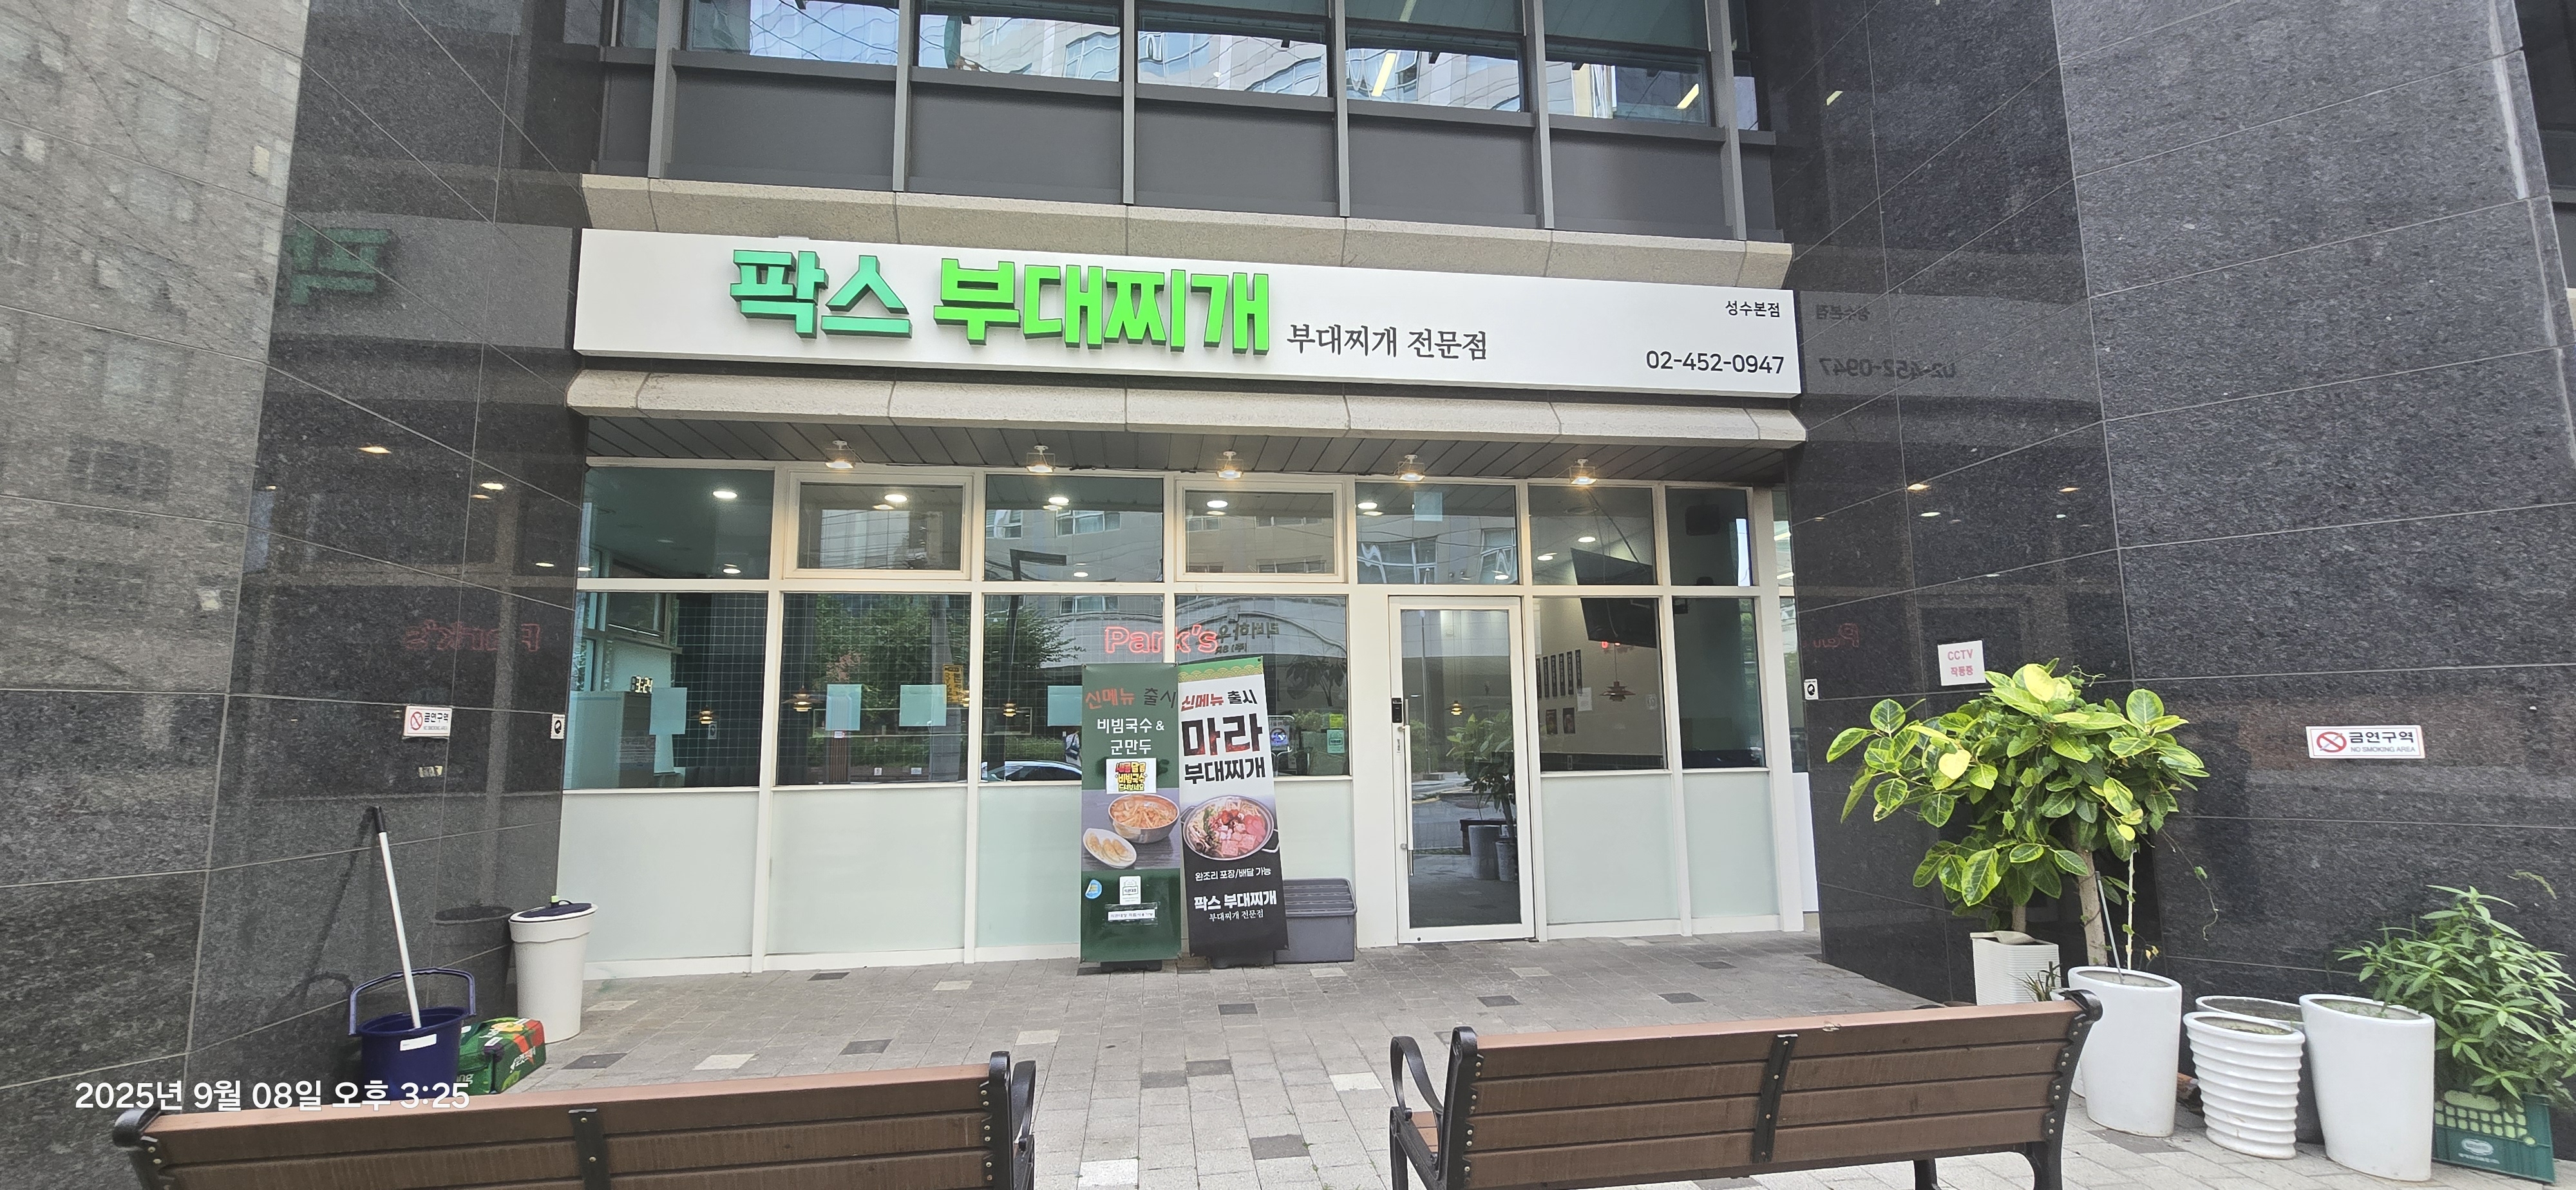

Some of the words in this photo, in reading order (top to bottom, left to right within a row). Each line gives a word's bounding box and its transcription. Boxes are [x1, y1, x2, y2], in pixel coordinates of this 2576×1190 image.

[730, 249, 913, 339] 팍스
[933, 258, 1270, 356] 부대찌개
[1725, 300, 1781, 317] 성수본점
[1287, 324, 1397, 357] 부대찌개
[1408, 328, 1486, 361] 전문점
[1646, 350, 1785, 374] 02-452-0947
[1947, 649, 1973, 661] CCTV
[1951, 666, 1973, 677] 작동중
[1085, 688, 1135, 710] 신메뉴
[1144, 688, 1177, 708] 출시
[1181, 694, 1224, 712] 신메뉴
[1227, 689, 1258, 704] 출시
[424, 712, 449, 723] 금연구역
[1097, 717, 1153, 734] 비빔국수
[1155, 720, 1165, 731] &
[1181, 713, 1264, 757] 마라
[2349, 731, 2414, 744] 금연구역
[1110, 739, 1151, 755] 군만두
[1184, 757, 1266, 784] 부대찌개
[1195, 871, 1218, 882] 완조리
[1220, 867, 1255, 879] 포장/배달
[1255, 867, 1271, 876] 가능
[1194, 896, 1222, 911] 팍스
[1224, 890, 1277, 909] 부대찌개
[1209, 911, 1240, 921] 부대찌개
[1241, 909, 1264, 919] 전문점
